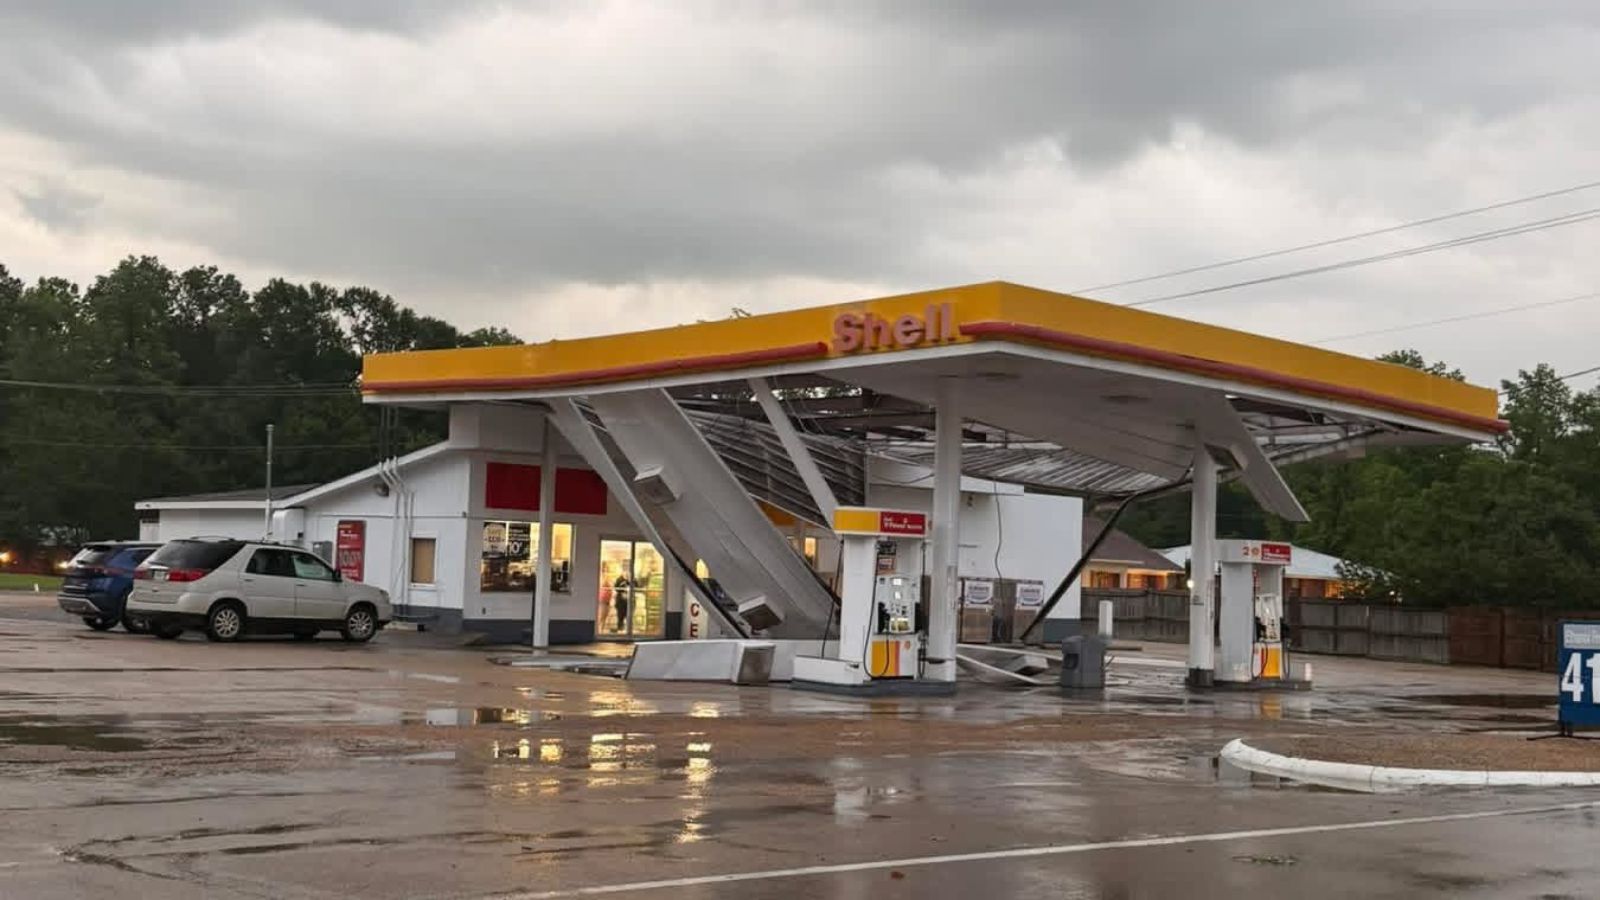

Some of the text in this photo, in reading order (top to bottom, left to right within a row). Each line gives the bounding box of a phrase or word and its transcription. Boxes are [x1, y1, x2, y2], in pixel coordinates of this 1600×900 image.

[831, 303, 955, 352] Shell
[690, 602, 700, 638] CE
[1561, 652, 1600, 704] 41
